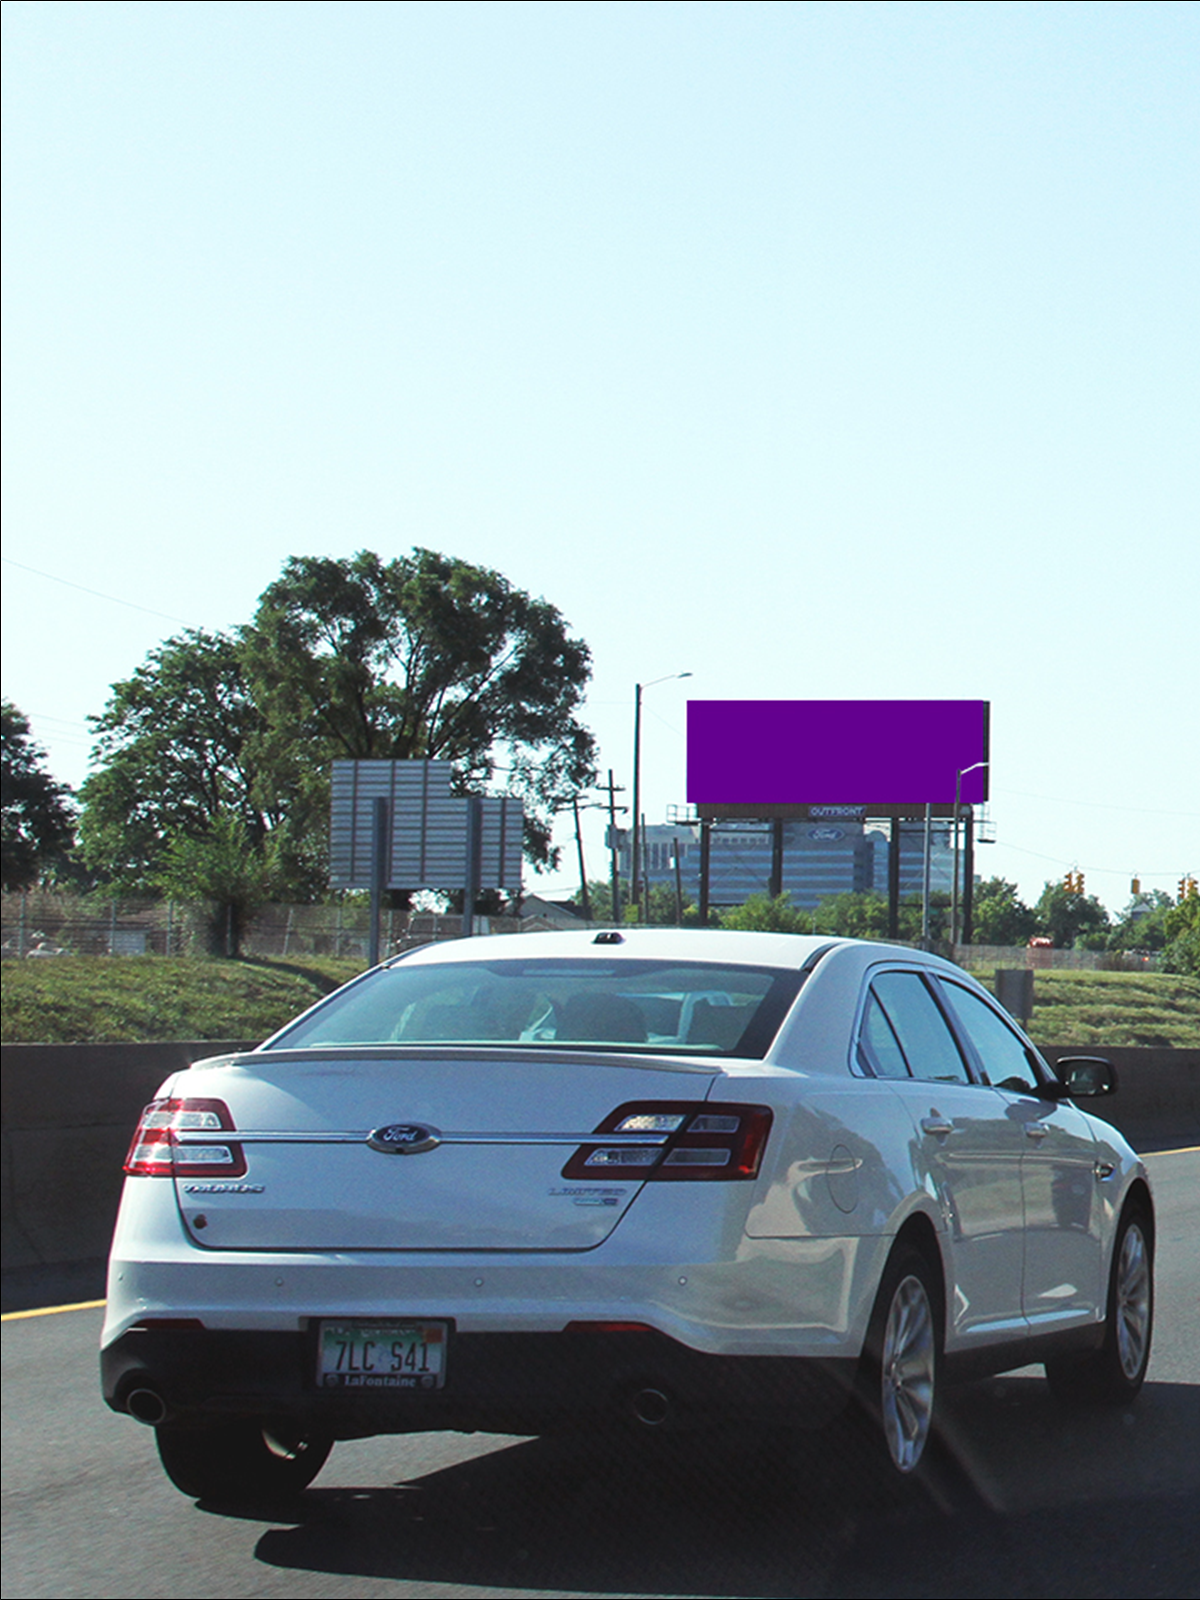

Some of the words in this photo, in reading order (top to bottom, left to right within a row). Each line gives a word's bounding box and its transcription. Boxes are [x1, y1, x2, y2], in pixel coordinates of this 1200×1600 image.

[810, 805, 864, 816] OUTFRONT
[382, 1126, 419, 1141] Ford
[335, 1340, 376, 1371] 7LC
[390, 1340, 430, 1372] S41
[344, 1374, 417, 1388] LaFontaine
